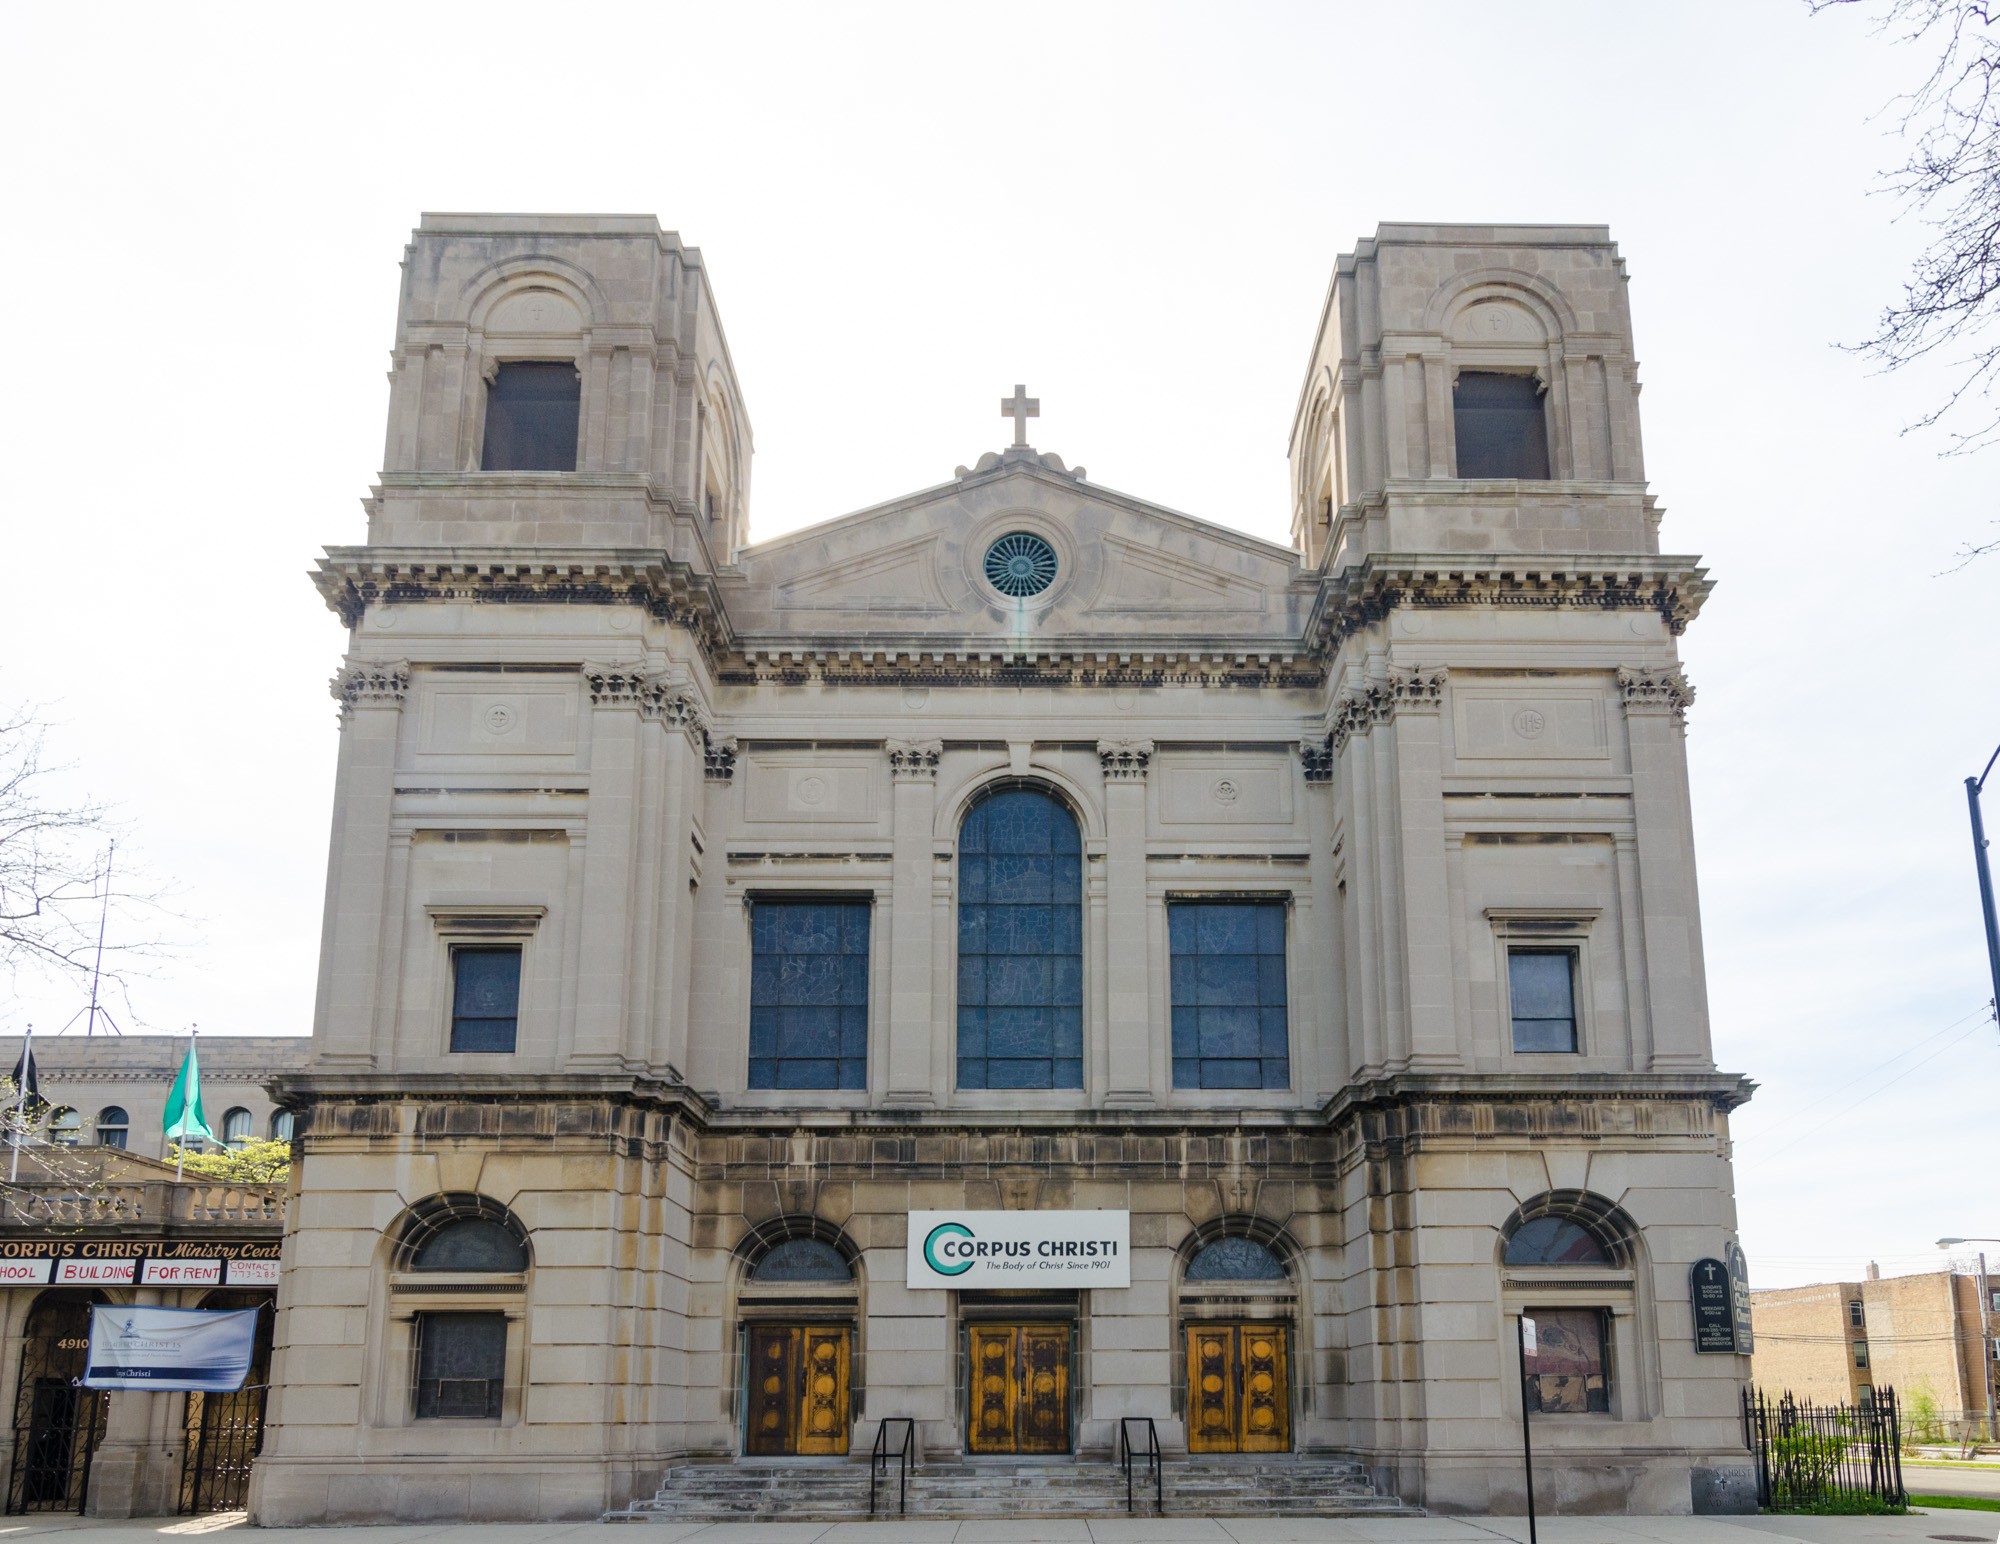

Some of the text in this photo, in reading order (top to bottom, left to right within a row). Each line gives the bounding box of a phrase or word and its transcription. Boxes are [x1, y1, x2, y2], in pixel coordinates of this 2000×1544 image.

[0, 1243, 75, 1257] ORPUS
[82, 1243, 163, 1257] CHRISTI
[165, 1243, 239, 1260] Ministry
[943, 1241, 1117, 1258] CORPUS CHRISTI
[230, 1261, 276, 1270] CONTACT
[986, 1261, 1111, 1272] The Body of Christ Since 1901
[64, 1265, 135, 1279] BUILDING
[147, 1266, 180, 1279] FOR
[183, 1267, 221, 1279] RENT
[57, 1338, 89, 1349] 4910
[126, 1368, 151, 1377] Christi
